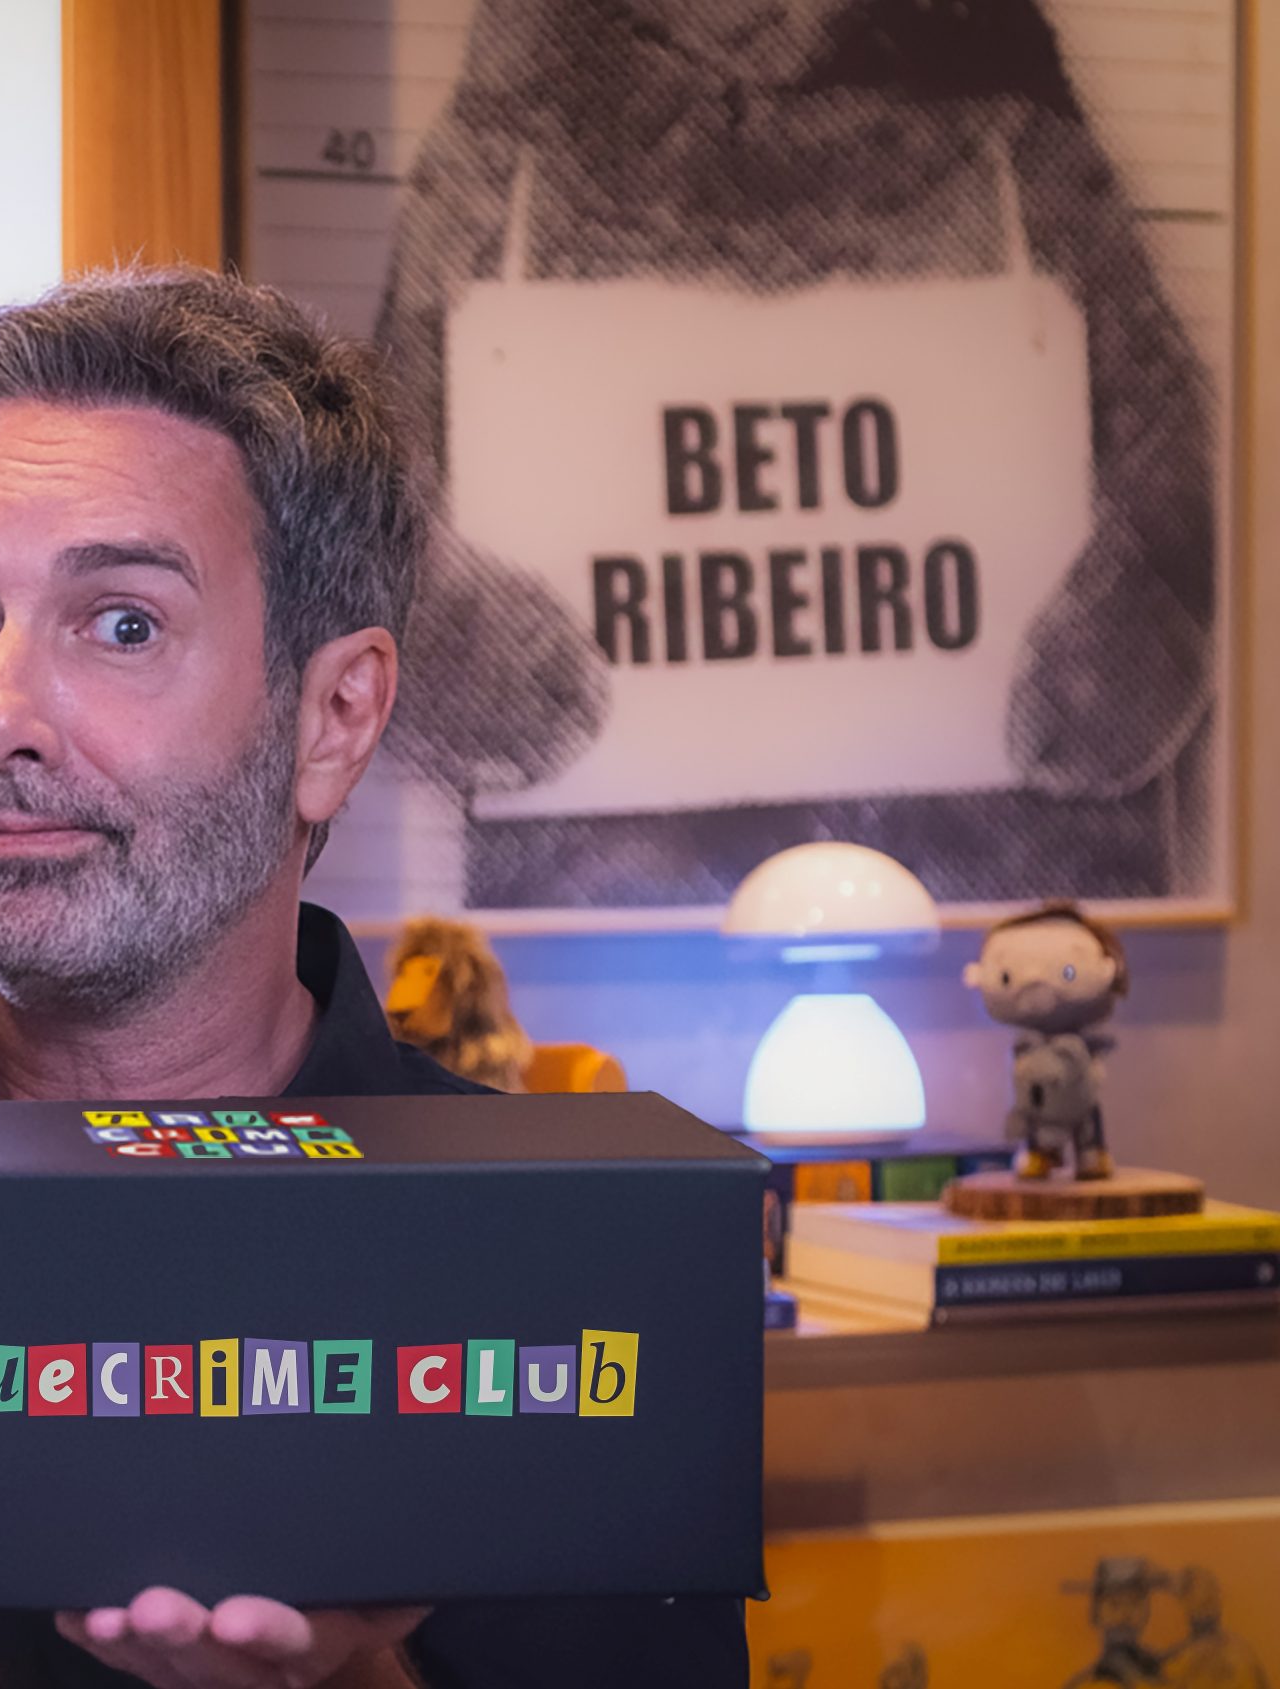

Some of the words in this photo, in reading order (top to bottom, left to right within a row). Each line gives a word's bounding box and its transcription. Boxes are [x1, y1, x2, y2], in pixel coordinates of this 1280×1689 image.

[322, 127, 376, 169] 40
[662, 396, 900, 515] BETO
[592, 539, 981, 664] RIBEIRO
